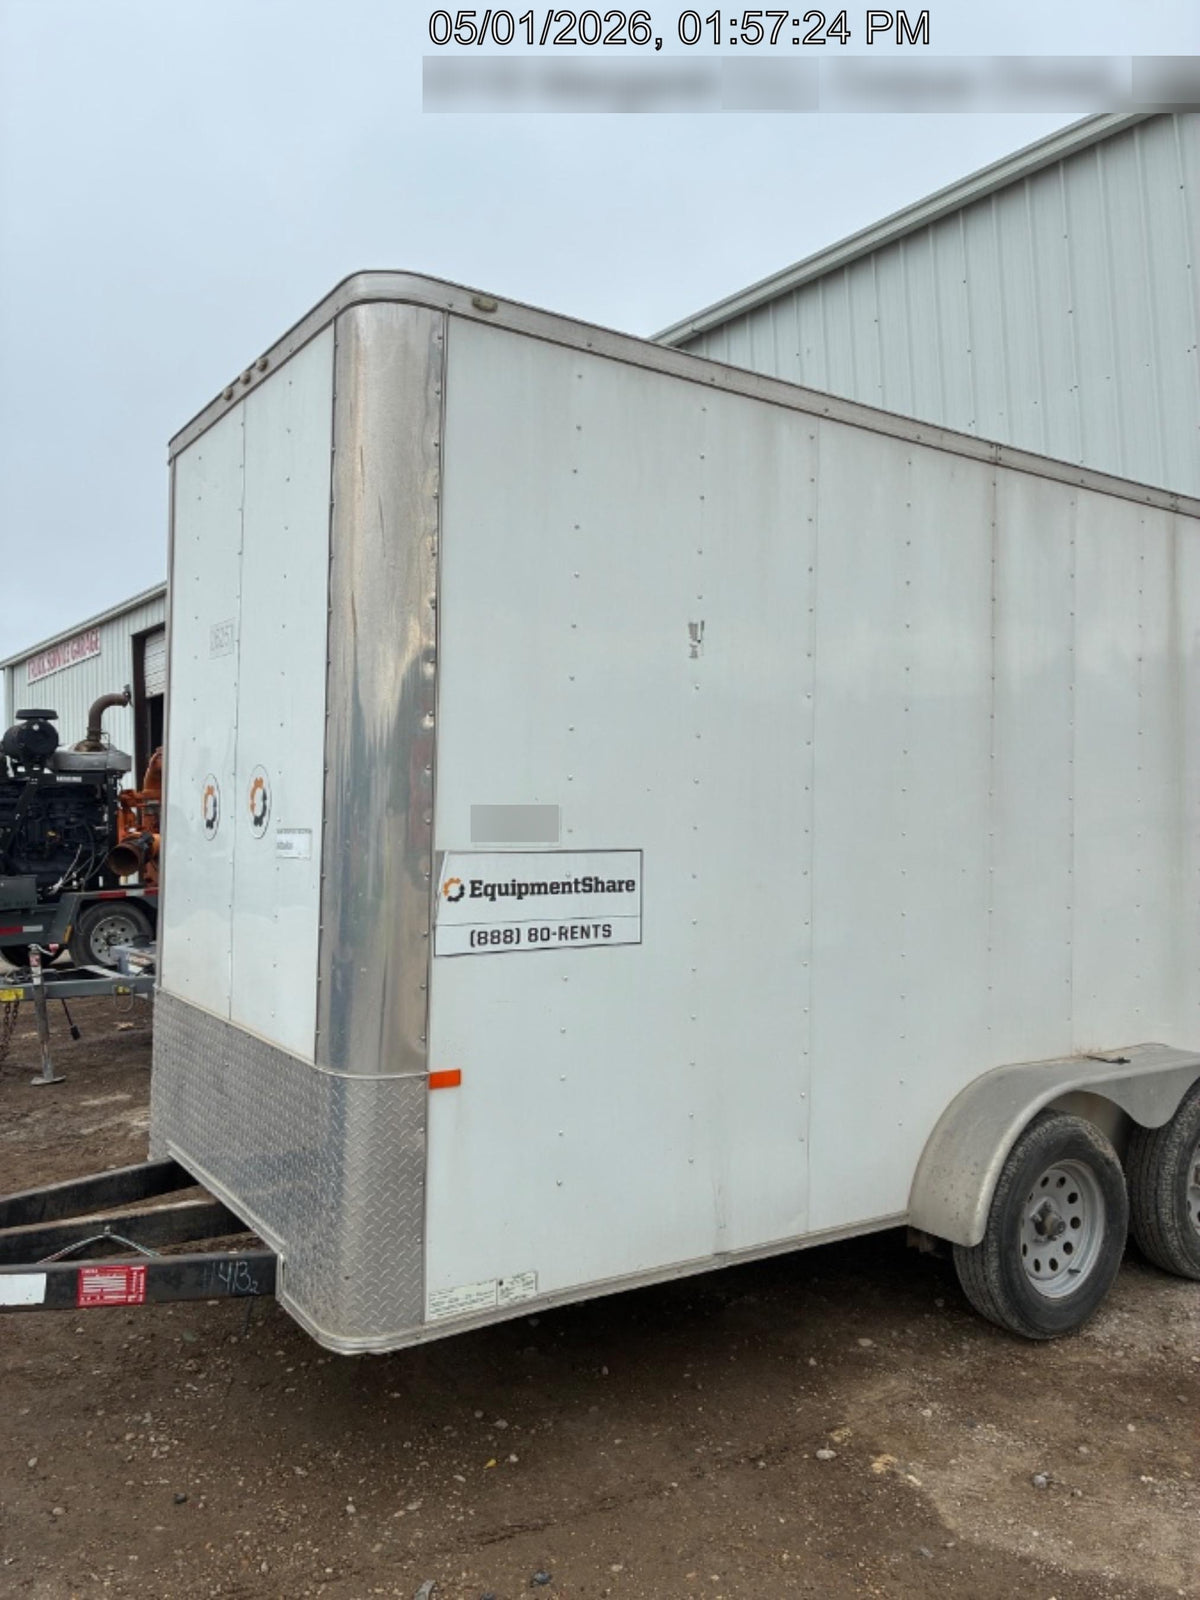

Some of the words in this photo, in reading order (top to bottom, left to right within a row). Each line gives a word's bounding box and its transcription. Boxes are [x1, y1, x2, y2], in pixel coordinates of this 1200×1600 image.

[469, 877, 636, 902] EquipmentShare
[469, 928, 521, 948] (888)
[527, 923, 612, 943] 80-RENTS
